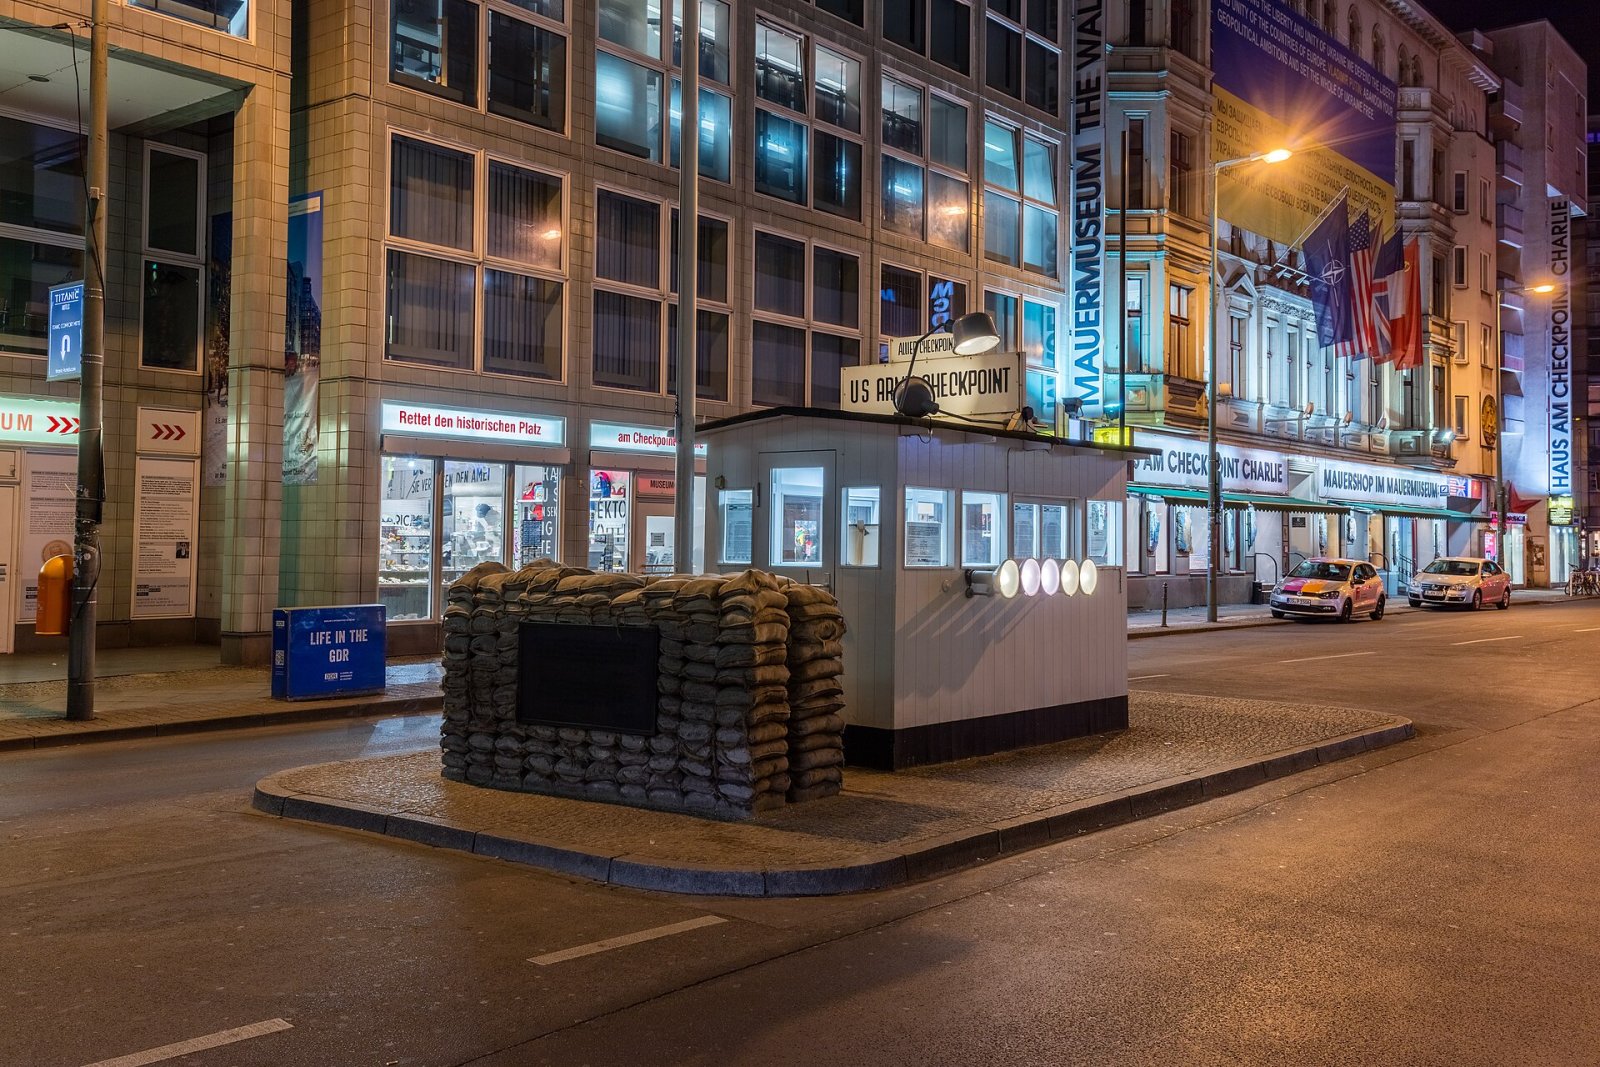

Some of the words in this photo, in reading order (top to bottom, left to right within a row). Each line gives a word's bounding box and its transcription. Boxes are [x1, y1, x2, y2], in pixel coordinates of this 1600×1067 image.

[1231, 0, 1248, 20] UNITY
[1250, 9, 1258, 26] OF
[1258, 16, 1269, 35] THE
[1270, 23, 1298, 53] COUNTRIES
[1299, 43, 1306, 59] OF
[1272, 6, 1293, 32] LIBERTY
[1294, 22, 1304, 40] AND
[1320, 39, 1326, 55] OF
[1217, 7, 1259, 47] GEOPOLITICAL
[1260, 35, 1288, 66] AMBITIONS
[1289, 55, 1299, 73] AND
[1300, 62, 1309, 79] SET
[1310, 68, 1319, 86] THE
[1338, 86, 1343, 100] OF
[1344, 90, 1362, 113] UKRAINE
[1076, 75, 1100, 135] THE
[1551, 200, 1568, 276] CHARLIE
[1074, 148, 1100, 406] MAUERMUSEUM
[54, 292, 79, 303] TITANIC
[919, 337, 954, 354] CHECKPOIN
[1552, 287, 1568, 398] CHECKPOIN
[850, 379, 870, 403] US
[399, 410, 431, 424] Rettet
[434, 414, 453, 428] den
[456, 416, 516, 433] historischen
[518, 421, 542, 436] Platz
[1552, 402, 1568, 434] AM
[618, 433, 630, 443] am
[1143, 453, 1164, 471] AM
[1168, 450, 1240, 478] CHECKOINT
[1242, 459, 1283, 483] CHARLIE
[1552, 438, 1569, 488] HAUS
[650, 480, 675, 489] MUSEUM
[1324, 470, 1373, 493] MAUERSHOP
[1376, 476, 1384, 494] IM
[1386, 478, 1438, 498] MAUERMUSEUM
[310, 631, 332, 646] LIFE
[336, 630, 346, 644] IN
[350, 628, 368, 643] THE
[329, 648, 350, 662] GDR
